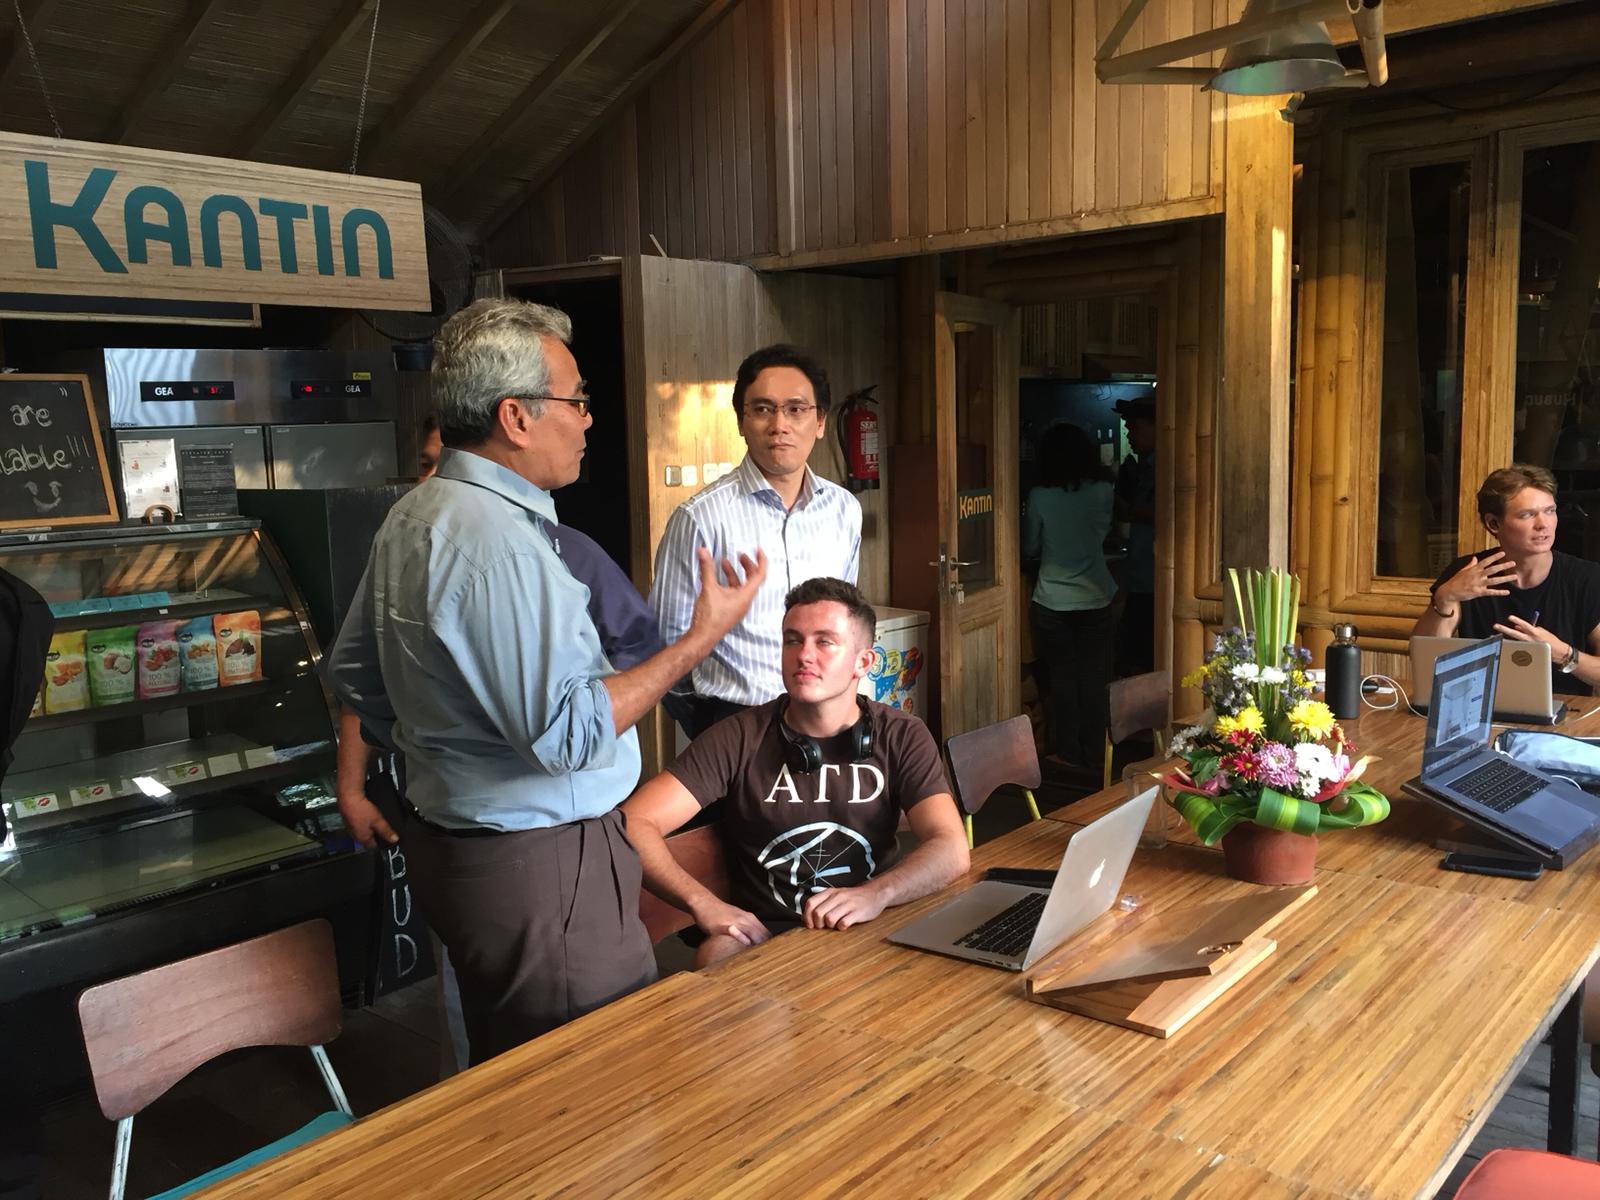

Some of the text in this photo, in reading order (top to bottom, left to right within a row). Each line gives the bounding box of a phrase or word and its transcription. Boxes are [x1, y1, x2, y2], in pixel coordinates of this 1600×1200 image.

[24, 160, 394, 279] KANTIN
[154, 386, 175, 396] GEA
[345, 385, 361, 393] GEA
[10, 404, 52, 427] are
[960, 494, 992, 519] KANTIN
[764, 762, 885, 804] ATD
